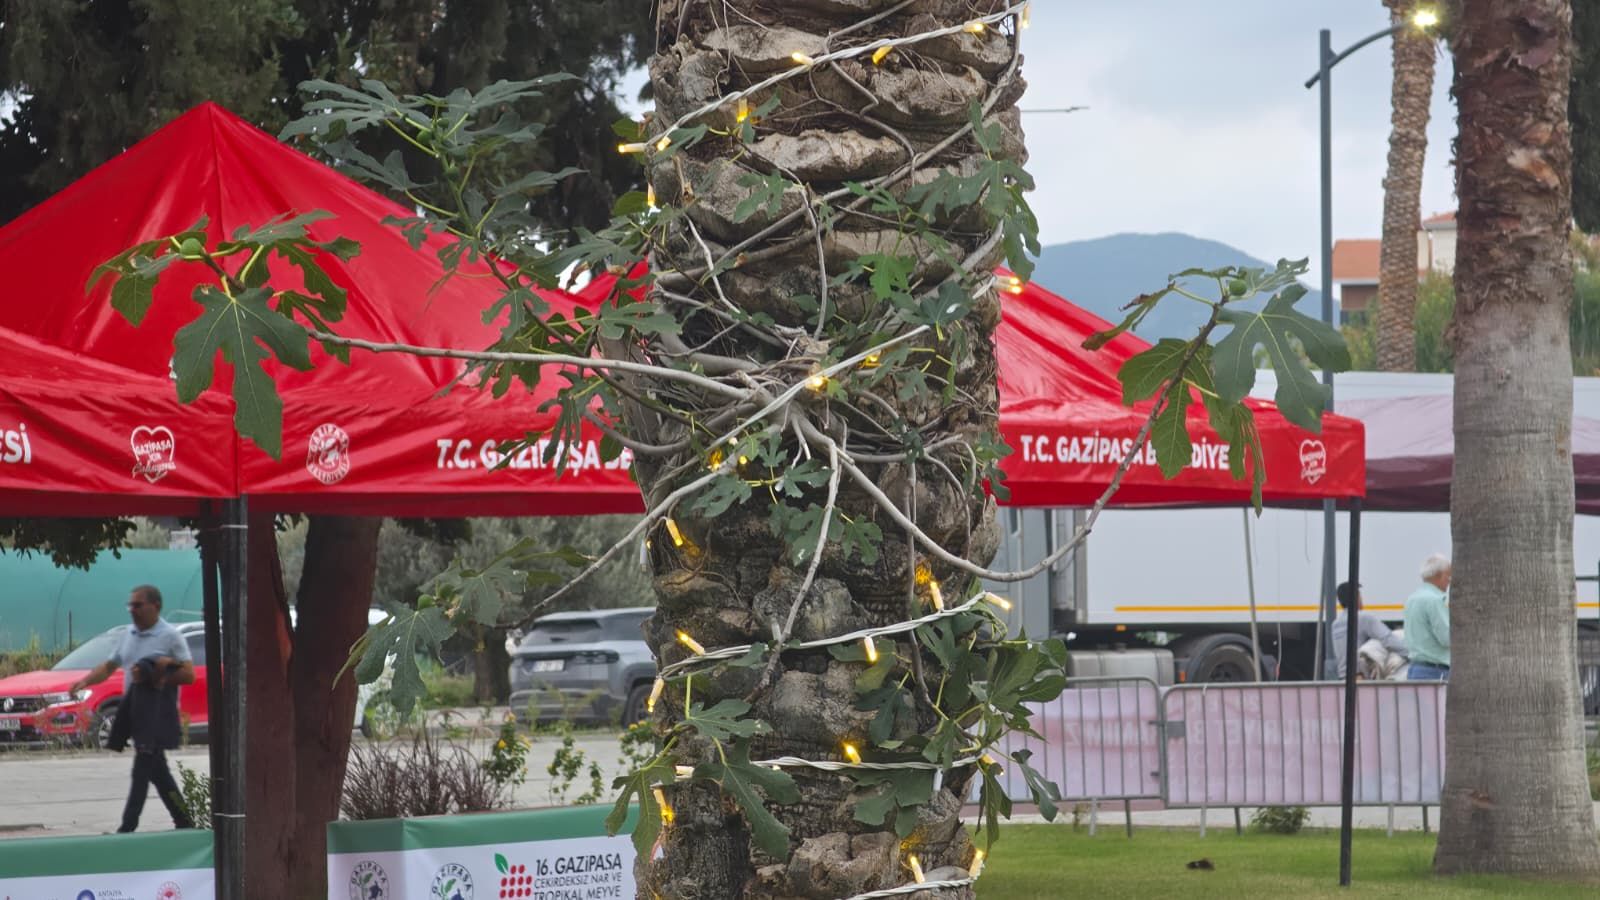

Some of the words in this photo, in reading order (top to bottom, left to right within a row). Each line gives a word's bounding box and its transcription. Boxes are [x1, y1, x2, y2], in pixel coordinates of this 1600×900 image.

[0, 422, 31, 464] Sİ
[436, 438, 476, 469] T.C.
[1020, 435, 1053, 462] T.C.
[536, 858, 553, 876] 16.
[612, 872, 622, 882] VE
[586, 885, 621, 899] MEYVE
